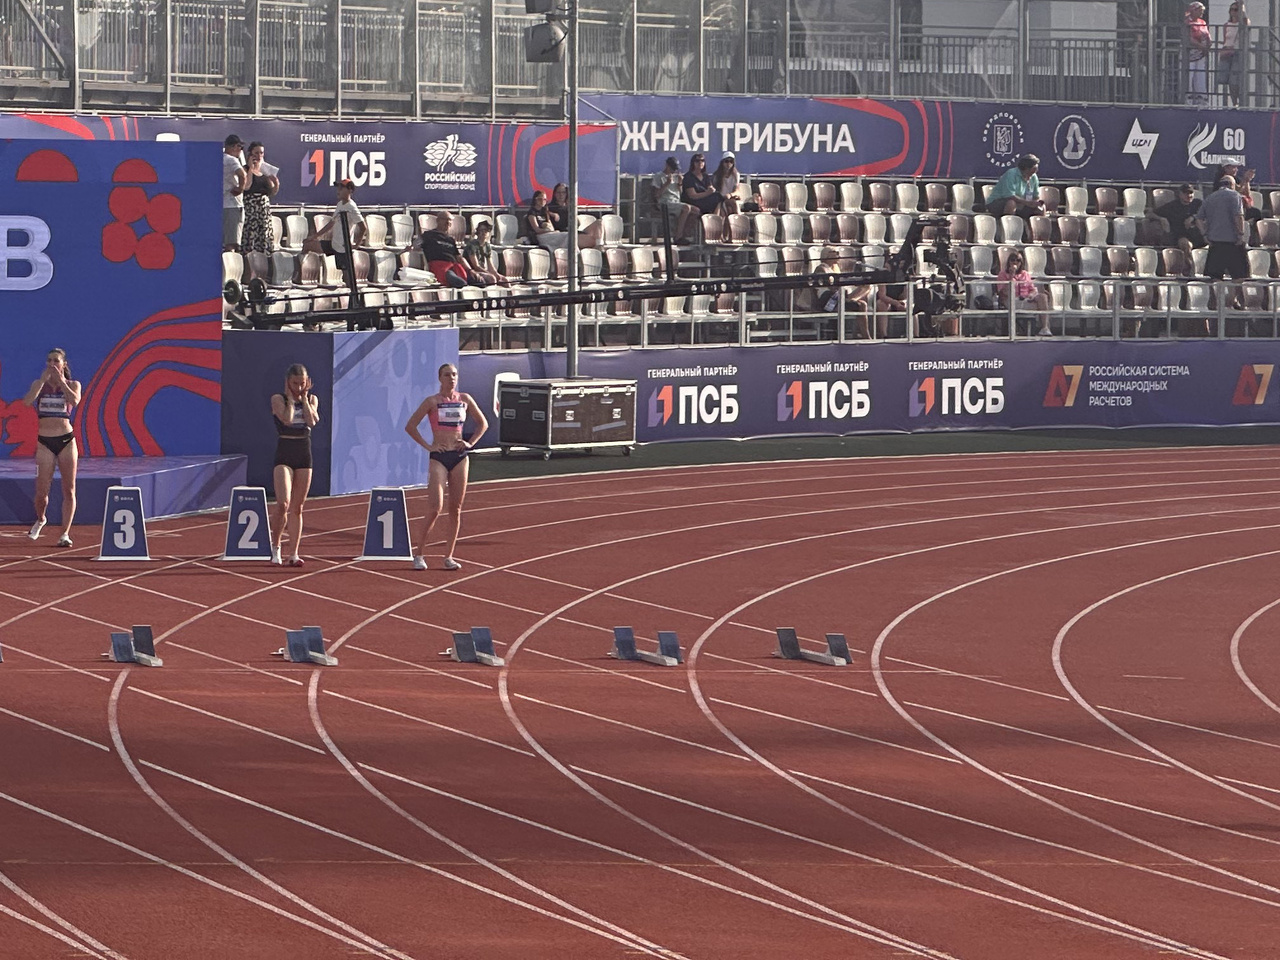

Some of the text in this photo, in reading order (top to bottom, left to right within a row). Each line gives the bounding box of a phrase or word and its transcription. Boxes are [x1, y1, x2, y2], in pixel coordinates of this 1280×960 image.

[300, 132, 386, 143] ГЕНЕРАЛЬНЫЙ ПАРТНЁР
[716, 122, 856, 153] ТРИБУНА
[1223, 128, 1245, 151] 60
[329, 150, 387, 187] ПСБ
[424, 171, 476, 182] РОССИЙСКИЙ
[647, 364, 738, 378] ГЕНЕРАЛЬНЫЙ ПАРТНЁР
[776, 360, 869, 374] ГЕНЕРАЛЬНЫЙ ПАРТНЁР
[908, 358, 1004, 371] ГЕНЕРАЛЬНЫЙ ПАРТНЁР
[1089, 364, 1190, 376] РОССИЙСКАЯ СИСТЕМА
[942, 377, 1005, 415] ПСБ
[1089, 381, 1168, 393] МЕЖДУНАРОДНЫХ
[679, 385, 739, 424] ПСБ
[808, 380, 871, 419] ПСБ
[1089, 396, 1132, 407] РАСЧЕТОВ
[112, 509, 137, 550] 3
[237, 509, 259, 549] 2
[376, 510, 394, 549] 1
